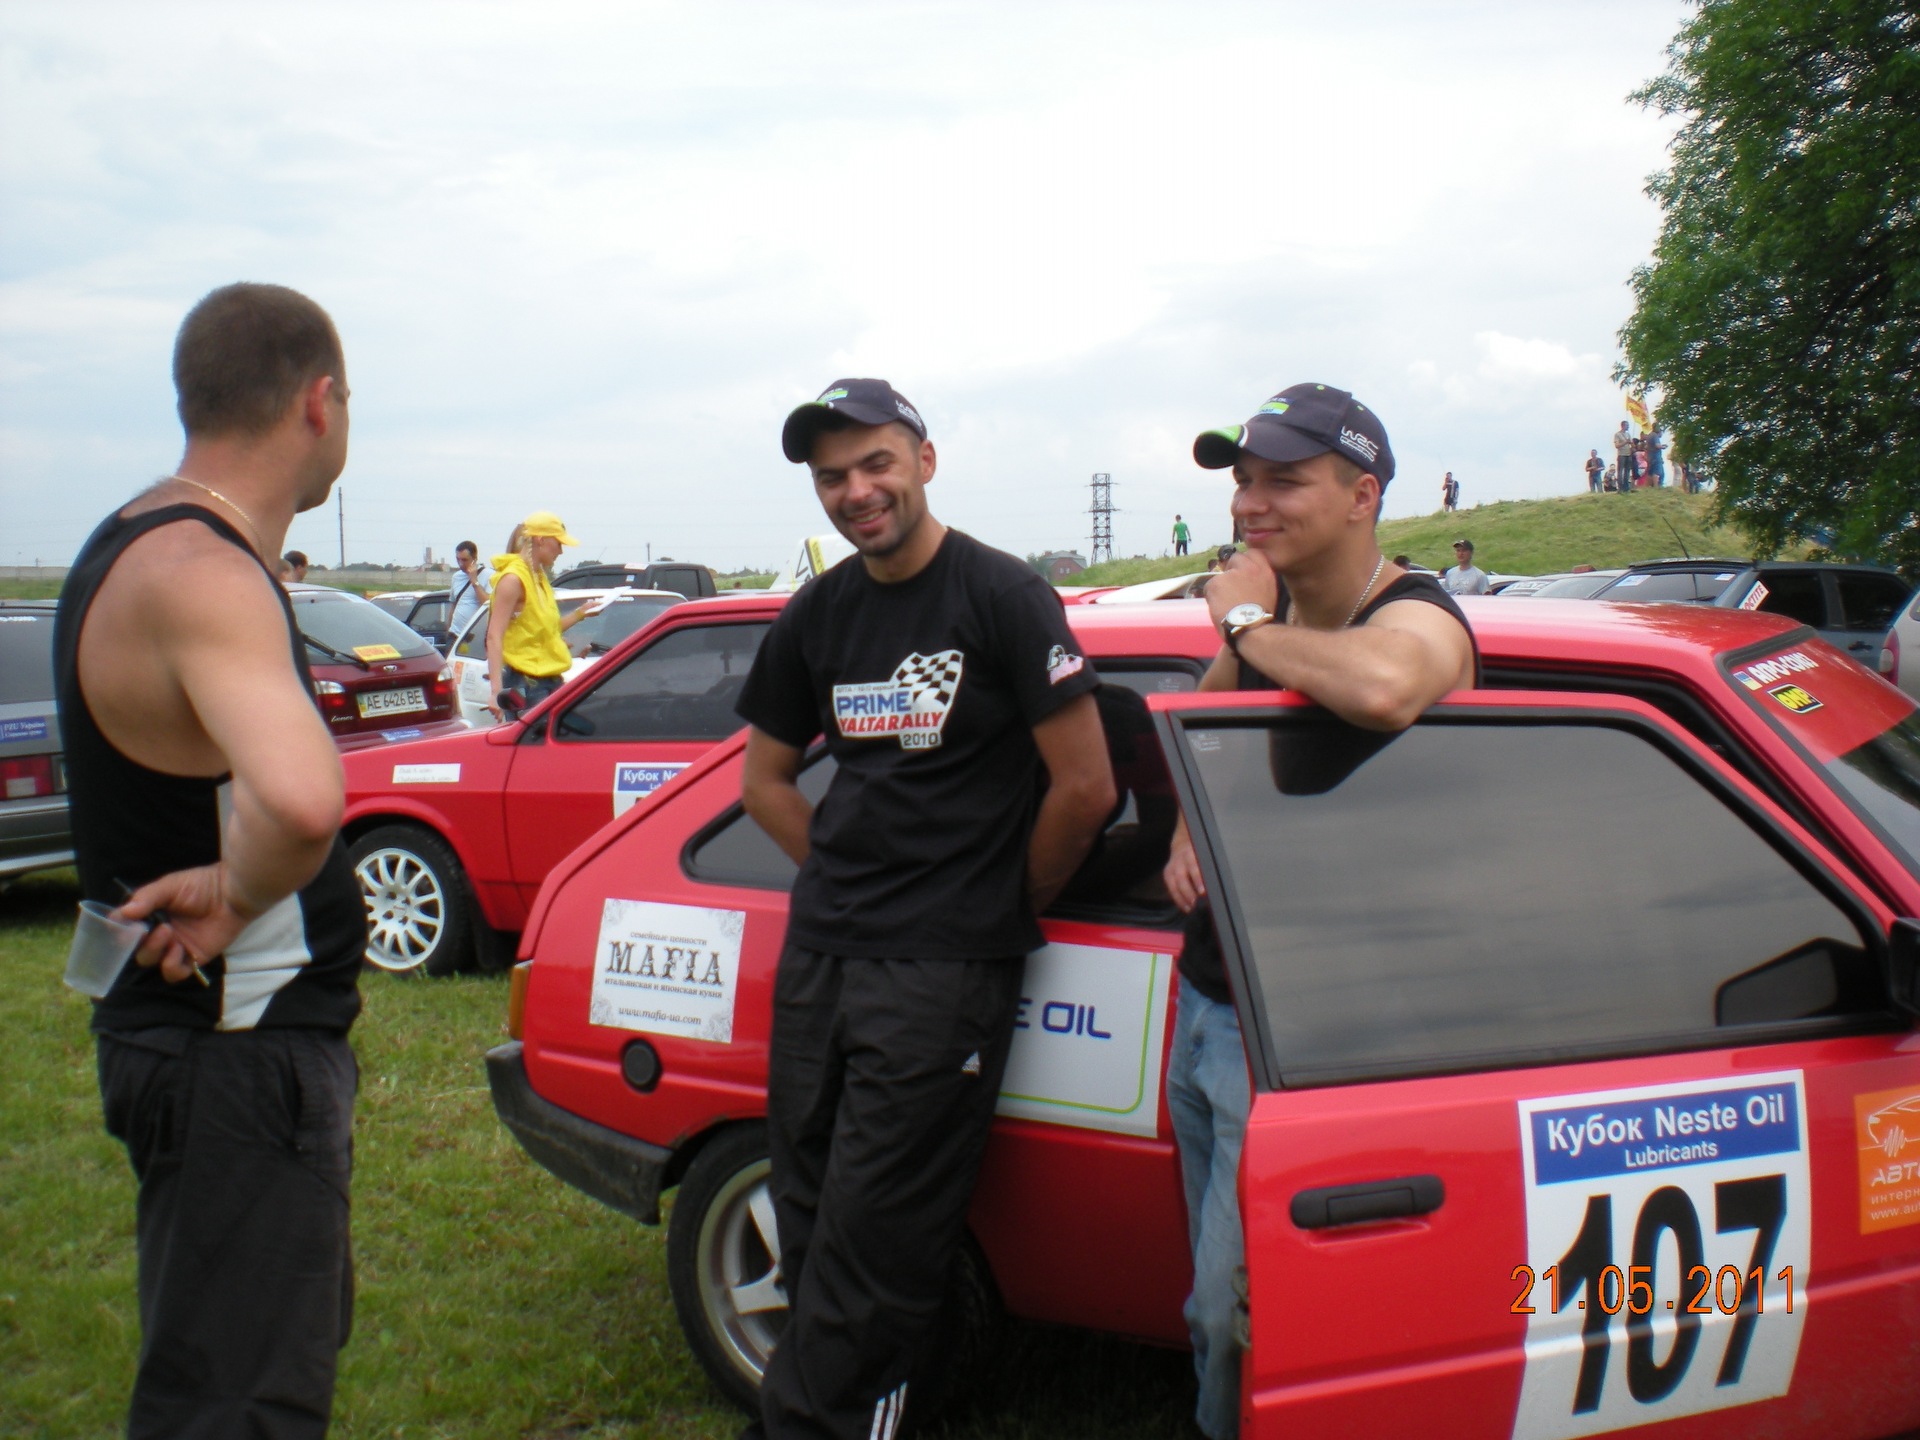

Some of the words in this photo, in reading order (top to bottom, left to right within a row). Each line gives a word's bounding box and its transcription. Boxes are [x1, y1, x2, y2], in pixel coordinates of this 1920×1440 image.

[367, 695, 382, 710] AE
[384, 692, 406, 707] 6426
[407, 690, 422, 705] BE
[836, 691, 911, 716] PRIME
[1776, 688, 1813, 709] OMP
[839, 711, 944, 732] YALTARALLY
[903, 732, 938, 746] 2010
[624, 770, 659, 783] Кубок
[630, 931, 668, 943] семейные
[669, 935, 707, 946] ценности
[606, 941, 723, 985] MAFIA
[604, 977, 652, 991] итальянская
[661, 985, 698, 996] японская
[699, 989, 722, 999] кухня
[619, 1006, 702, 1026] www.mafia-ua.com
[1042, 1001, 1112, 1039] OIL
[1547, 1113, 1643, 1157] Кубок
[1655, 1101, 1738, 1139] Neste
[1746, 1093, 1786, 1127] Oil
[1625, 1142, 1718, 1168] Lubricants
[1871, 1161, 1920, 1187] АВТ
[1556, 1174, 1788, 1416] 107
